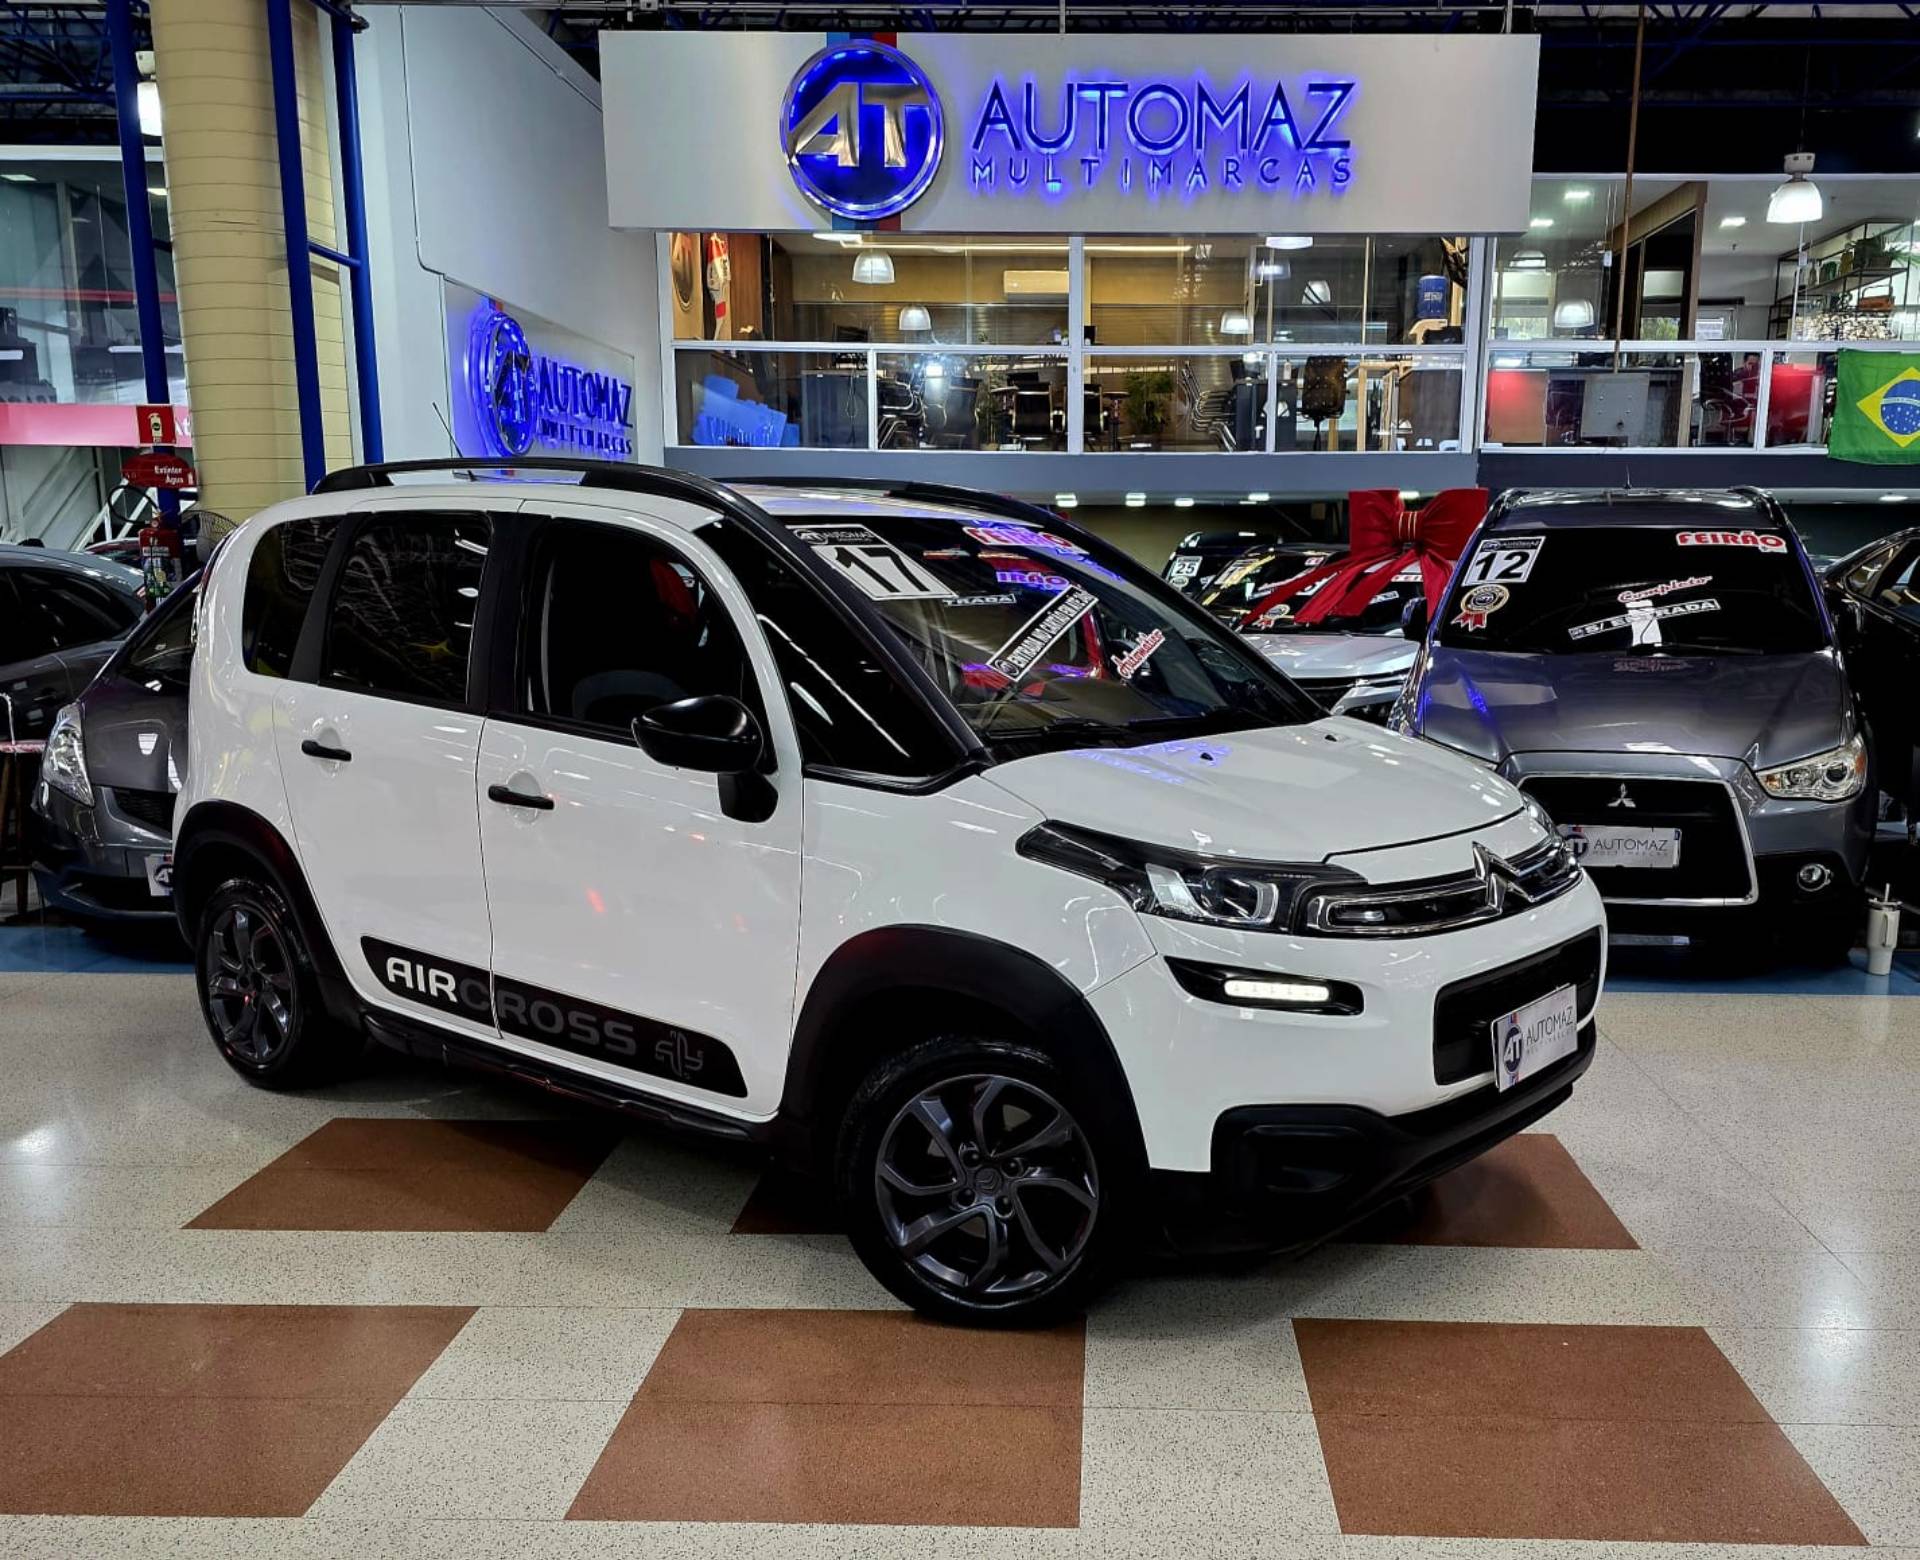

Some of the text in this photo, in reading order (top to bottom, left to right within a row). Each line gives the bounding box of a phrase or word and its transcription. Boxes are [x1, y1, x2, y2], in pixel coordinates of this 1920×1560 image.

[788, 82, 930, 167] AT
[971, 80, 1356, 151] AUTOMAZ
[971, 158, 1352, 187] MULTIMARCAS
[538, 357, 633, 428] AUTOMAZ
[1677, 530, 1785, 548] FEIRÃO
[834, 547, 930, 592] 17
[1175, 562, 1196, 575] 25
[1475, 551, 1530, 581] 12
[1618, 577, 1712, 602] Completo
[1593, 838, 1668, 851] AUTOMAZ
[386, 955, 637, 1055] AIRCROSS
[1526, 1005, 1574, 1046] AUTOMAZ
